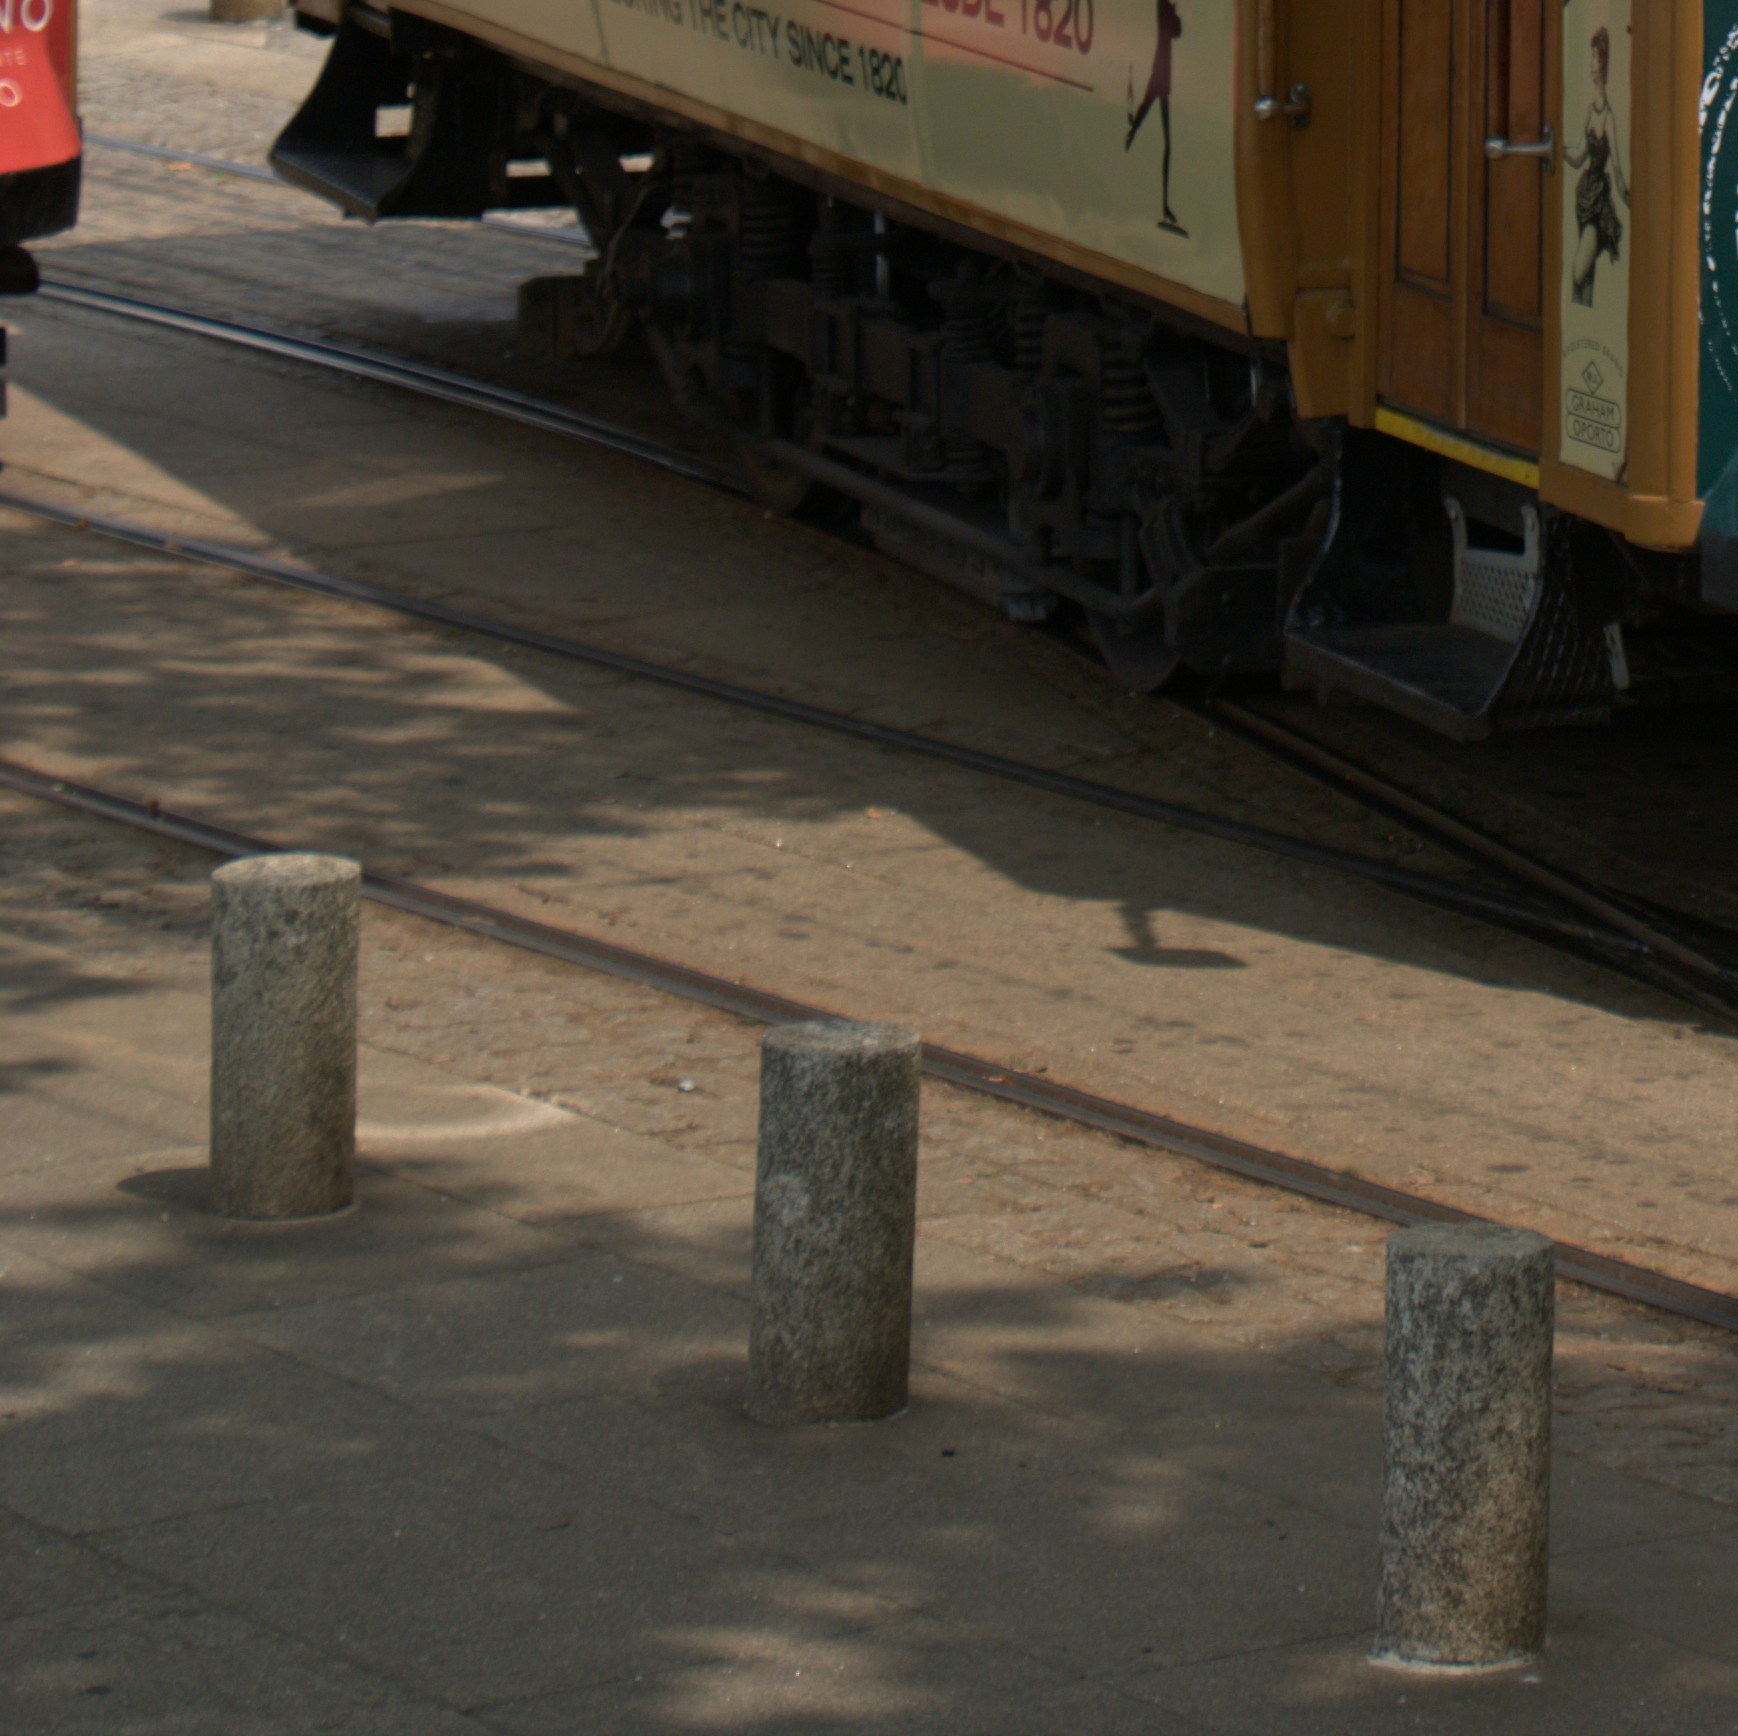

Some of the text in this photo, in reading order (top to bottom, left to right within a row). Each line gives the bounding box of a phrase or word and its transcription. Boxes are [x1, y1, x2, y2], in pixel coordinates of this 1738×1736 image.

[732, 1, 781, 59] CITY
[785, 19, 855, 87] SINCE
[1571, 394, 1615, 423] GRAHAM
[1572, 419, 1615, 448] OPORTO
